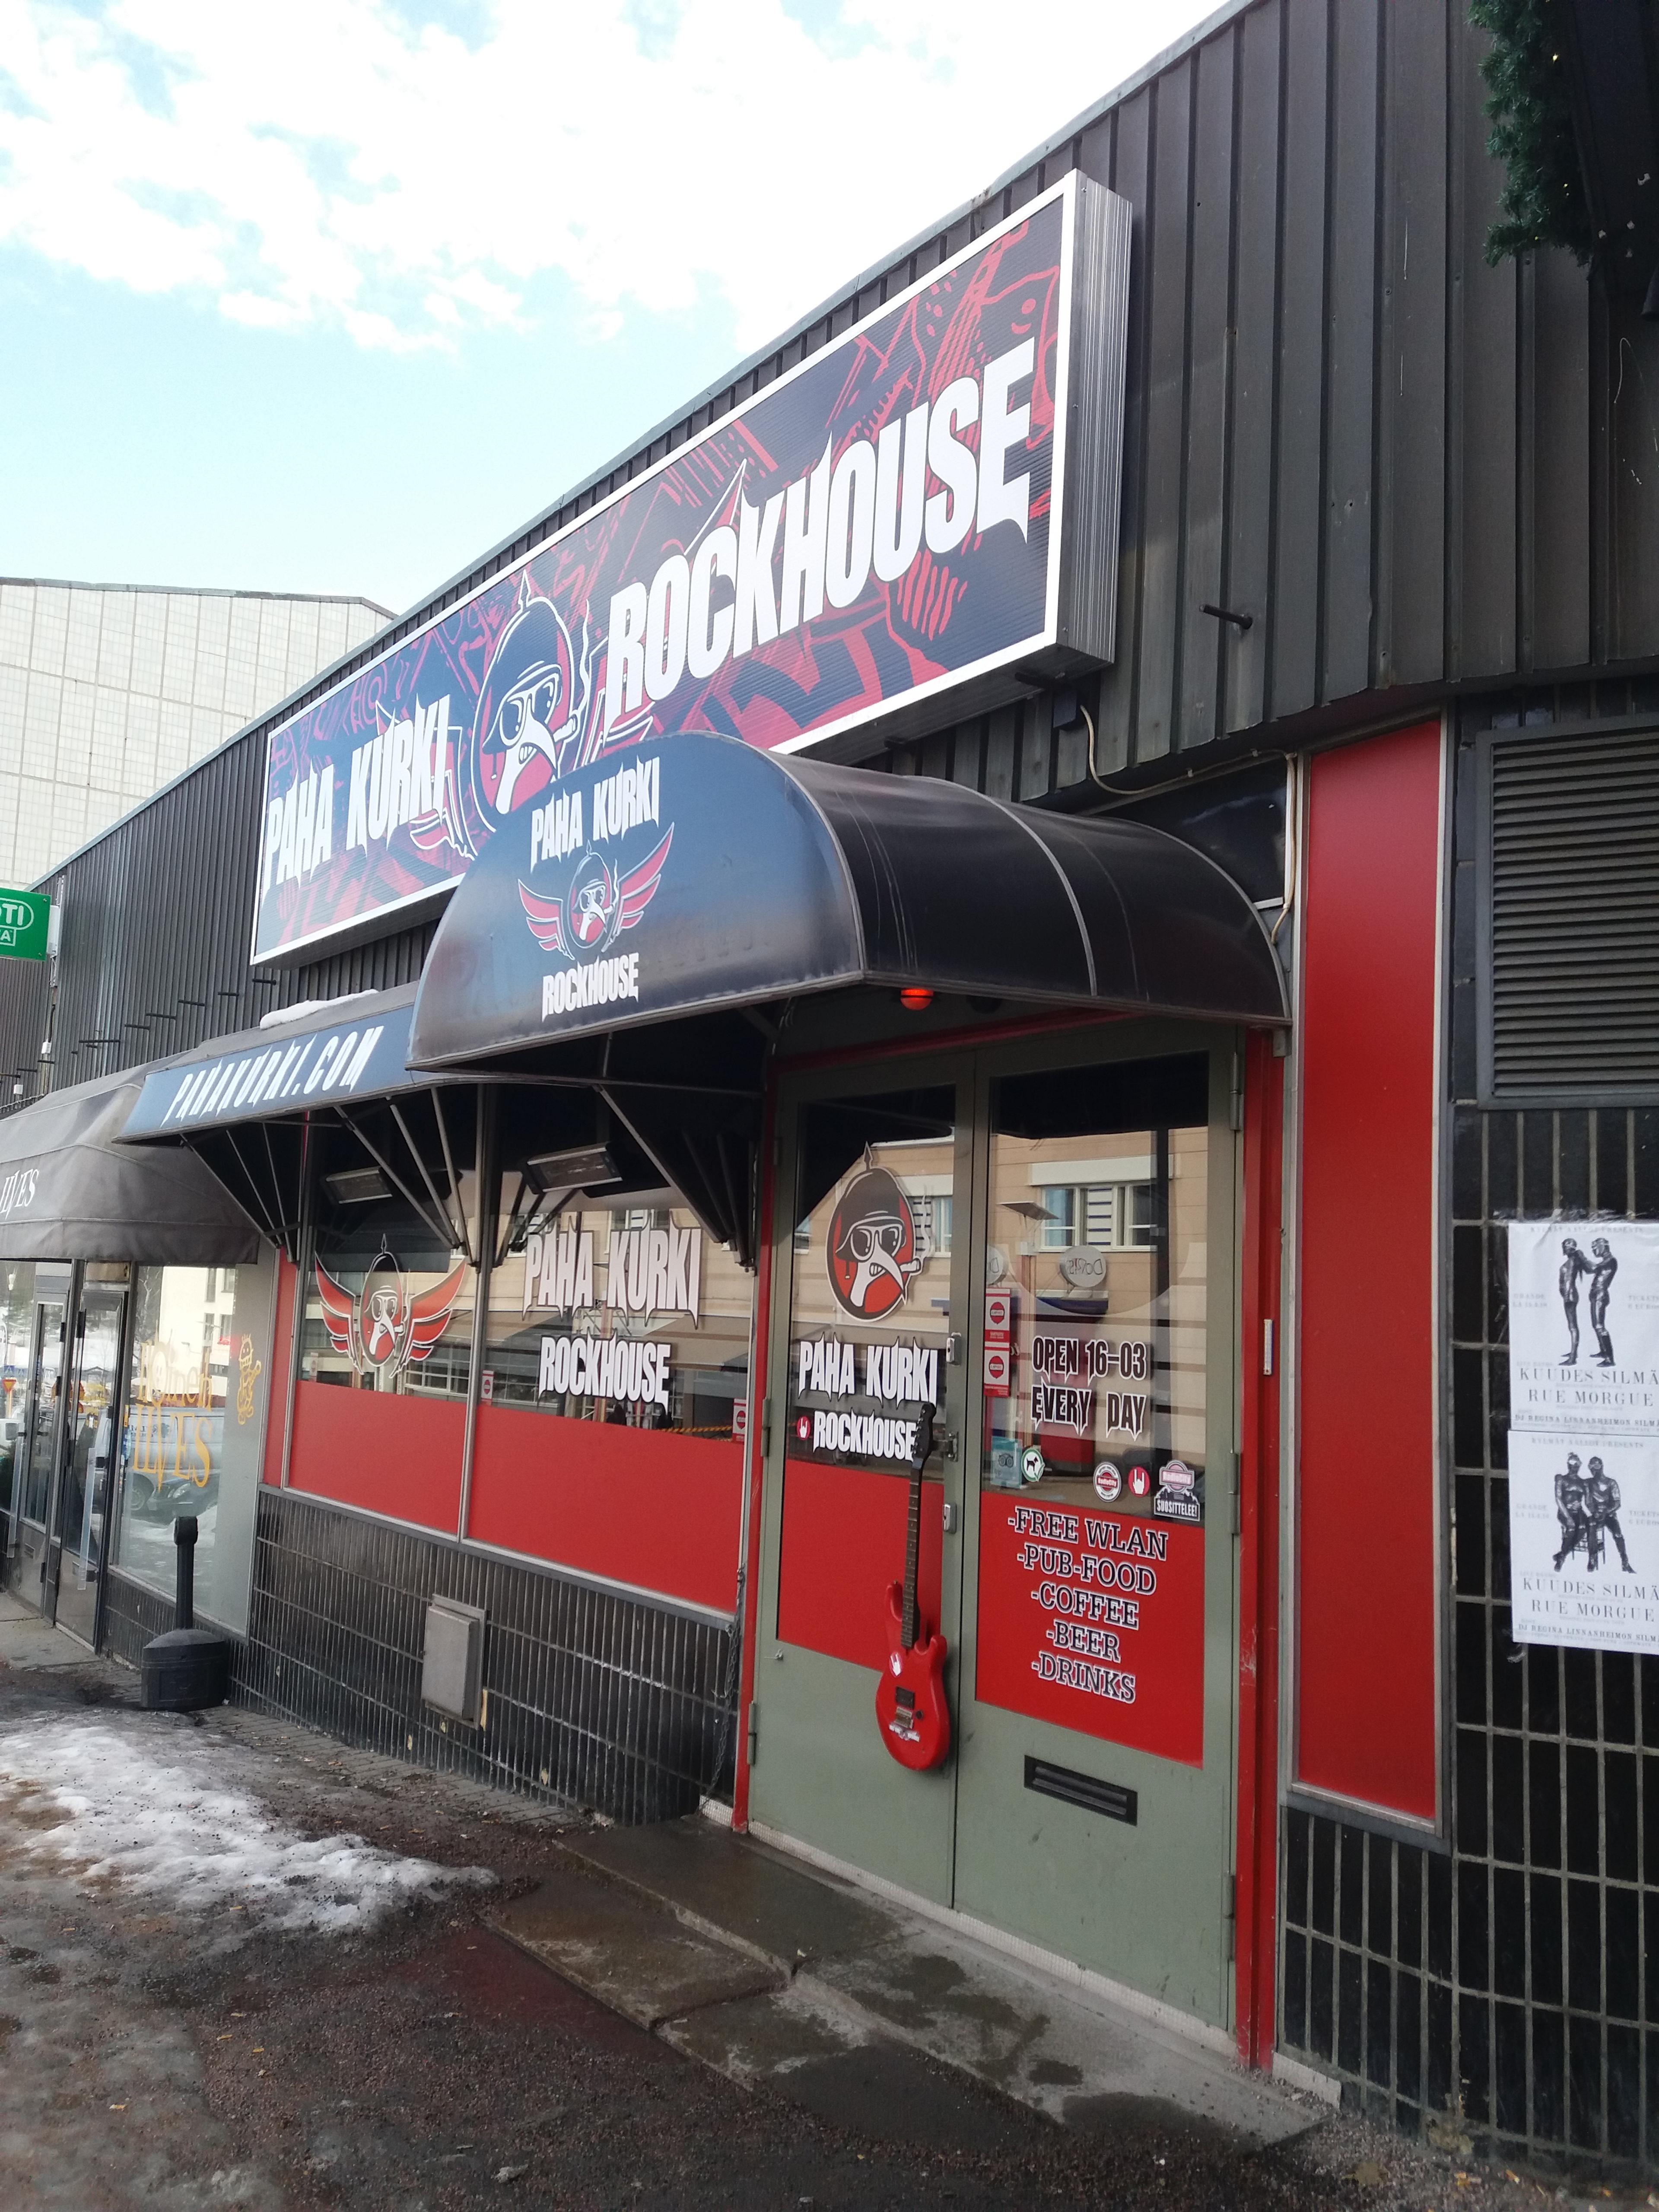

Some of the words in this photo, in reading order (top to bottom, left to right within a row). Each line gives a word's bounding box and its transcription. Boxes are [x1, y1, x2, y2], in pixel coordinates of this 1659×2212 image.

[604, 337, 1034, 747] ROCKHOUSE
[262, 759, 334, 909] PAHA
[346, 693, 450, 858] KURKI
[531, 788, 583, 874] PAHA
[593, 755, 660, 844] KURKI
[541, 952, 639, 1022] ROCKHOUSE
[160, 1025, 384, 1128] PAHAKURKI.COM
[522, 1215, 594, 1321] PAHA
[607, 1209, 702, 1329] KURKI
[539, 1328, 671, 1413] ROCKHOUSE
[798, 1332, 855, 1401] PAHA
[866, 1336, 938, 1409] KURKI
[1032, 1336, 1079, 1382] OPEN
[1087, 1339, 1147, 1386] 16-03
[1520, 1367, 1593, 1382] KUUDES
[1601, 1370, 1659, 1385] SILMÄ
[1031, 1376, 1091, 1436] EVERY
[1106, 1392, 1146, 1441] DAY
[1529, 1389, 1566, 1403] RUE
[1575, 1391, 1653, 1407] MORGUE
[132, 1403, 212, 1493] ILVES
[813, 1407, 916, 1462] ROCKHOUSE
[1157, 1499, 1197, 1517] SUOSITTELEE!
[1085, 1518, 1168, 1560] WLAN
[1017, 1542, 1157, 1595] -PUB-FOOD
[1523, 1578, 1594, 1595] KUUDES
[1603, 1584, 1659, 1600] SILMÄ
[1031, 1581, 1138, 1630] -COFFEE
[1532, 1599, 1568, 1615] RUE
[1577, 1603, 1654, 1622] MORGUE
[1046, 1618, 1121, 1663] -BEER
[1532, 1625, 1562, 1634] REGINA
[1636, 1634, 1659, 1643] SILM
[1031, 1650, 1136, 1704] -DRINKS
